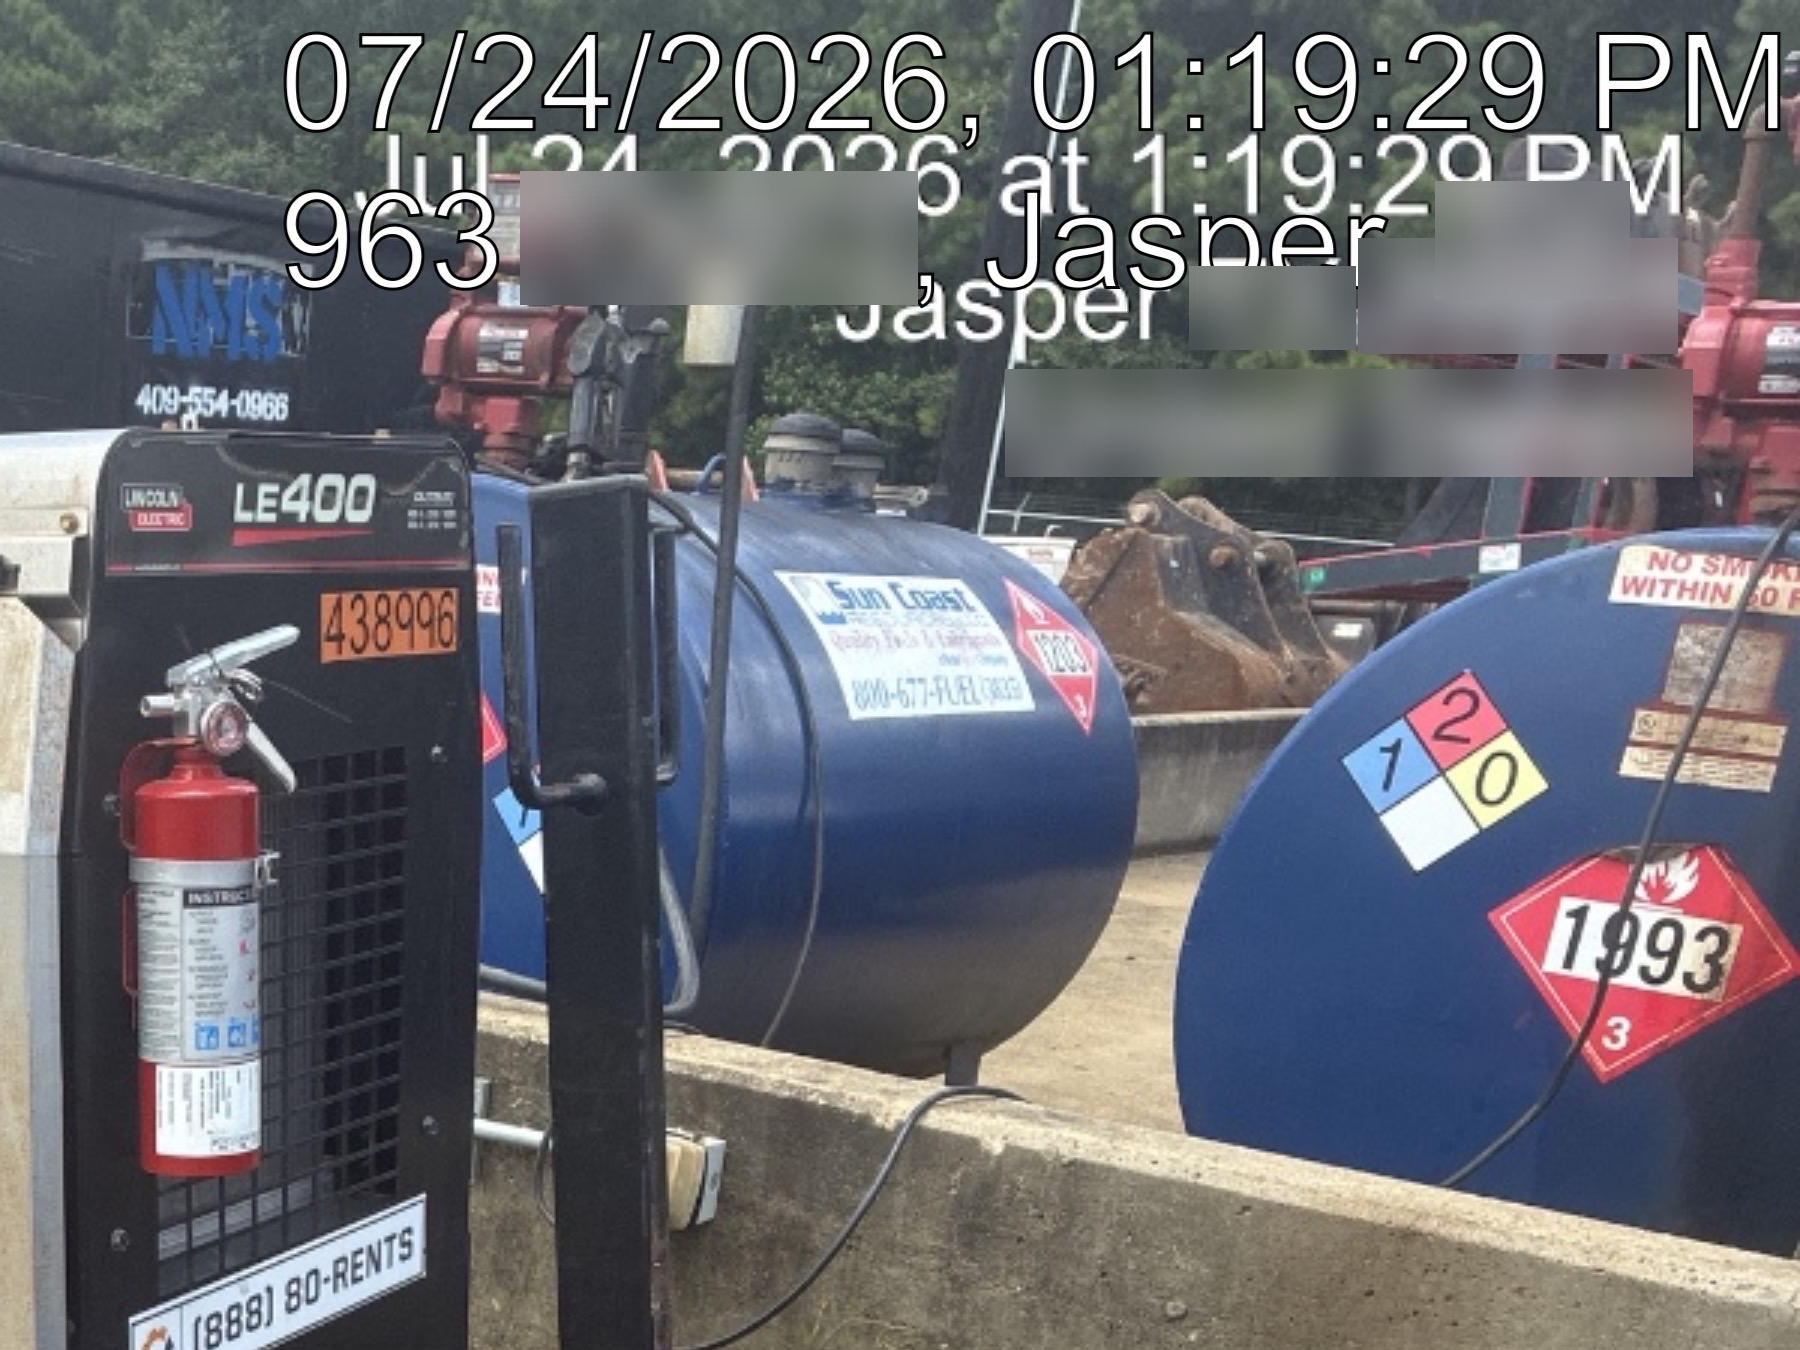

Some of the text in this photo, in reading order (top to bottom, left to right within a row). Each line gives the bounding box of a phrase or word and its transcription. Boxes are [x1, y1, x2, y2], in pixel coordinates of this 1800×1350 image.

[233, 473, 376, 524] LE400
[1621, 575, 1734, 604] WITHIN
[1648, 551, 1693, 572] NO
[322, 590, 456, 657] 438996
[1432, 687, 1481, 744] 2
[1378, 736, 1403, 792] 1
[1474, 751, 1518, 807] 0
[1561, 903, 1731, 994] 1993
[1601, 1015, 1632, 1050] 3
[284, 1225, 414, 1315] 80-RENTS
